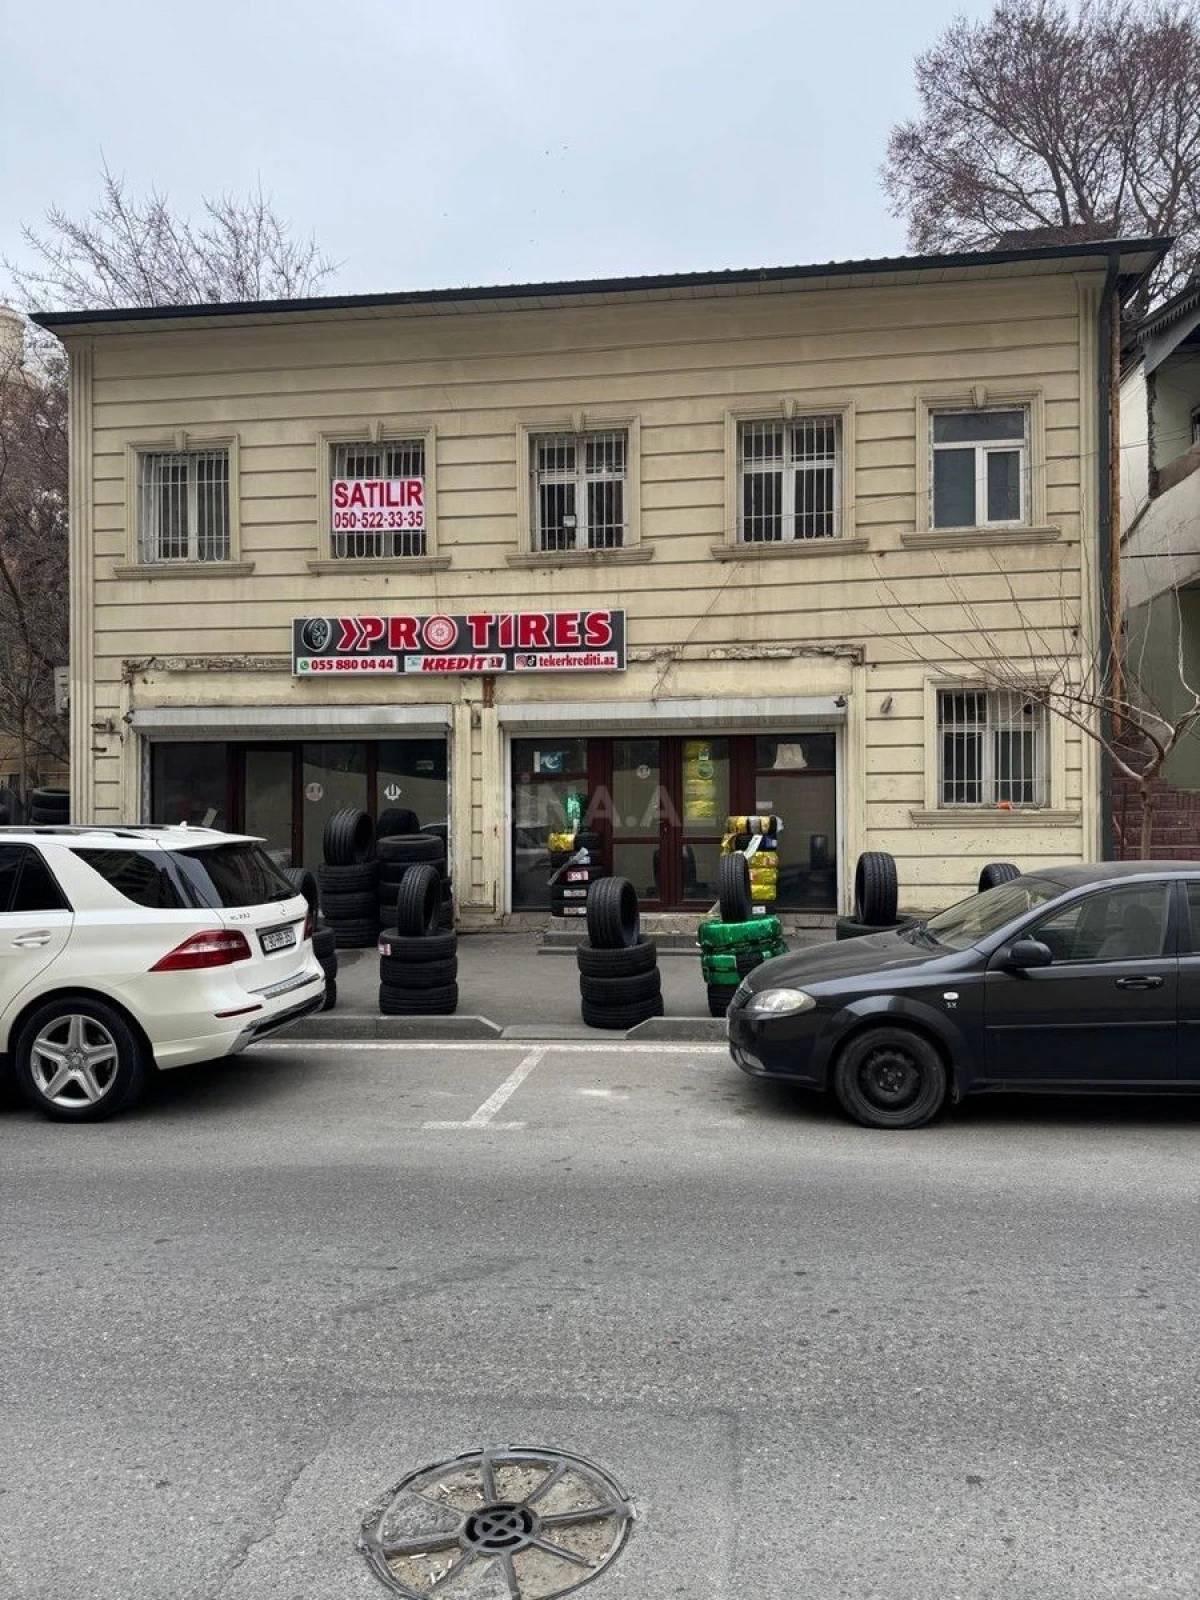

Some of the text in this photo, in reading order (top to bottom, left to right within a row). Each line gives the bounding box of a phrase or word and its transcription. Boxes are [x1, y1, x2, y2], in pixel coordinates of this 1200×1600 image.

[334, 481, 424, 508] SATILIR
[334, 511, 424, 529] 050-522-33-35
[356, 614, 458, 651] PRO
[311, 659, 394, 670] 055 880 04 44
[539, 653, 615, 667] tekerkrediti.az
